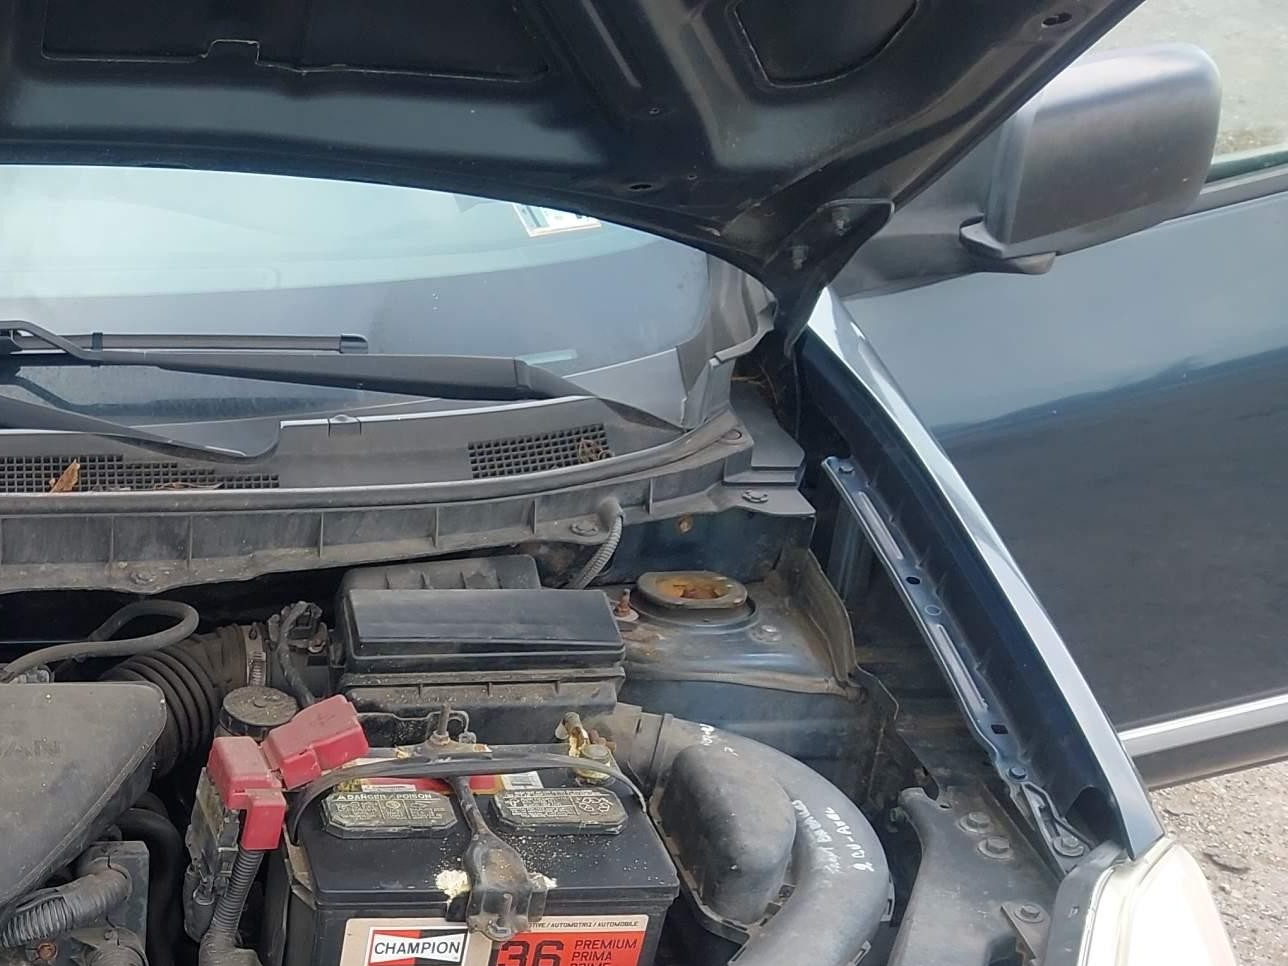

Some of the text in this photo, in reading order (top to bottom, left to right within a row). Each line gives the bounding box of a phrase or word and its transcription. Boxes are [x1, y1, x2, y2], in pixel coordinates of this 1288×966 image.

[373, 942, 461, 955] CHAMPION
[574, 939, 638, 950] PREMIUM
[571, 951, 612, 961] PRIMA
